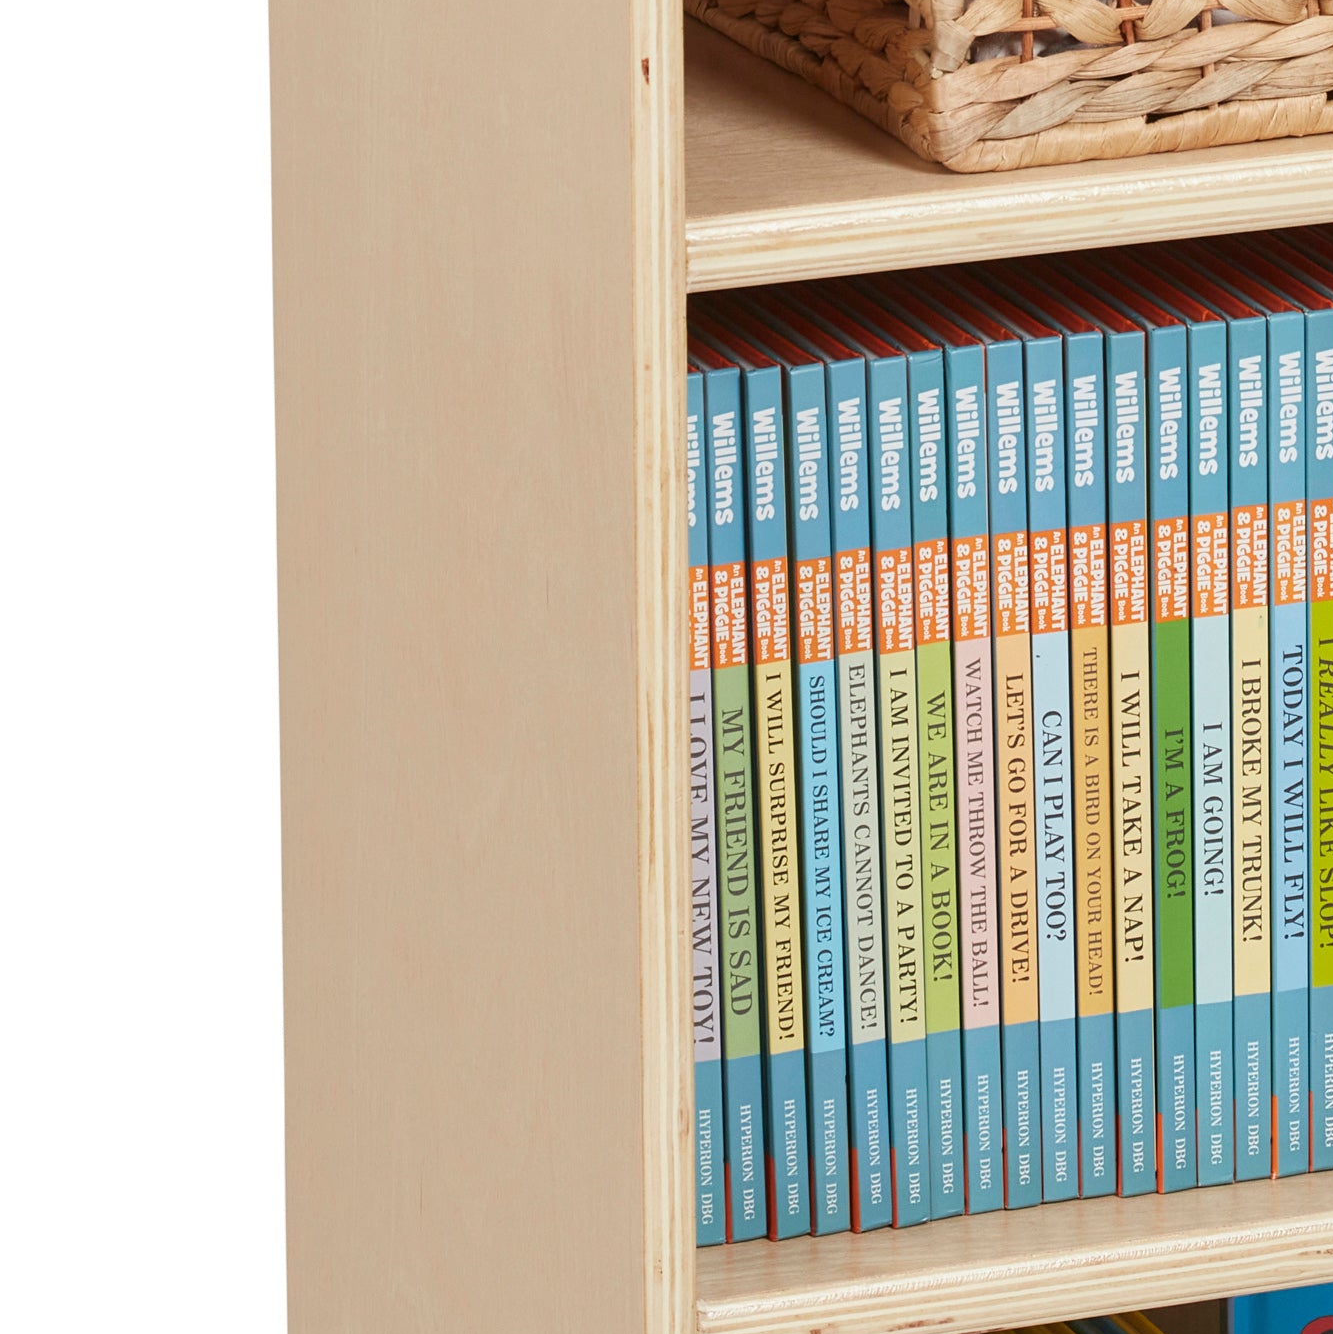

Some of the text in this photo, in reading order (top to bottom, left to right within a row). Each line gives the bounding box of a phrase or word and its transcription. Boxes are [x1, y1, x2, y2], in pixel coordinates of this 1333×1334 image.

[712, 412, 735, 526] Willems
[722, 707, 754, 1015] MY FRIEND IS SAD
[927, 690, 953, 982] WE ARE IN A BOOK!
[740, 1104, 755, 1220] HYPERION DBG
